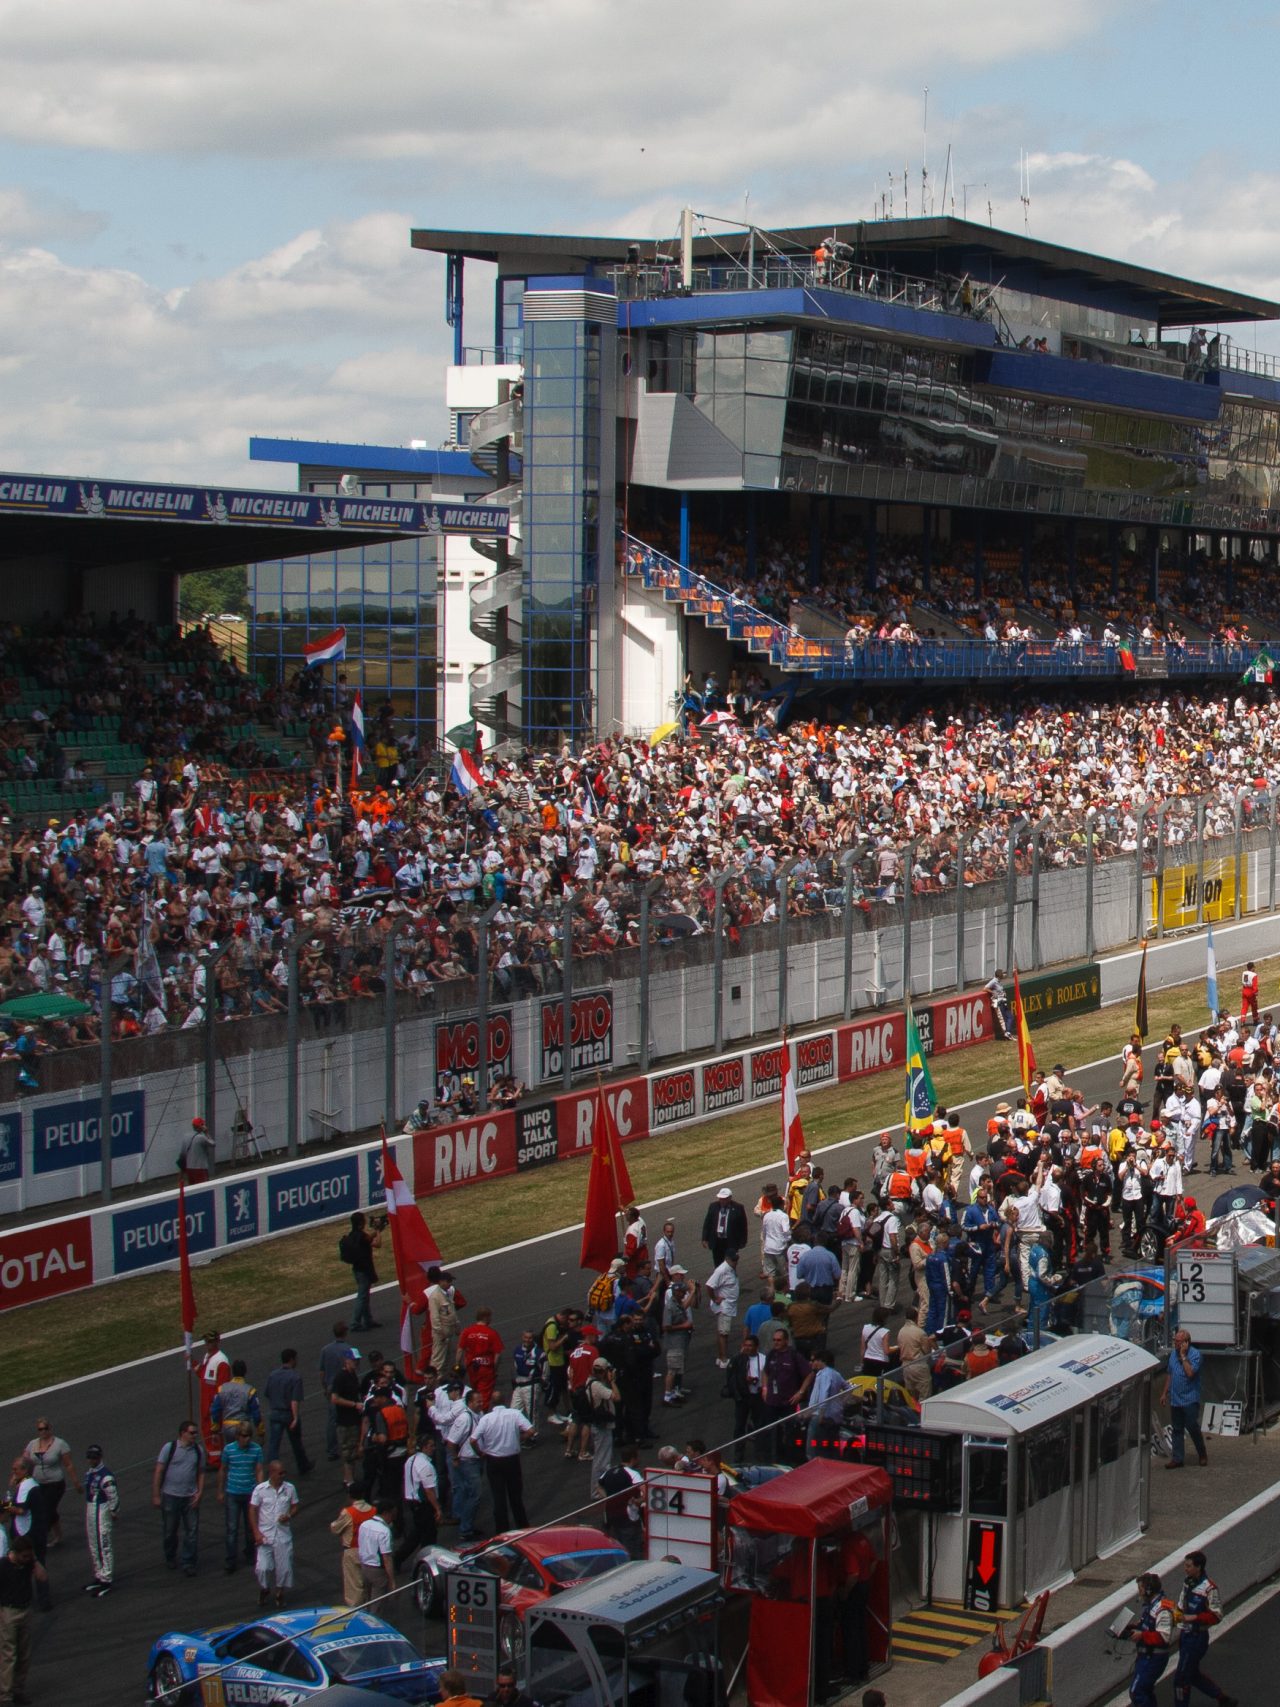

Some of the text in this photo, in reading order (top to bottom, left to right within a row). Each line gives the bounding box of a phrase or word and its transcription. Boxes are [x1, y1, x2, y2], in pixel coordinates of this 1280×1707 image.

[107, 489, 194, 511] MICHELIN
[231, 497, 310, 518] MICHELIN
[343, 504, 414, 523] MICHELIN
[444, 510, 508, 528] MICHELIN
[1010, 995, 1043, 1016] RLEX
[1057, 982, 1088, 1004] ROLEX
[945, 999, 984, 1048] RMC
[797, 1036, 833, 1069] MOTO
[850, 1022, 894, 1073] RMC
[702, 1060, 744, 1095] MOTO
[752, 1049, 783, 1082] MOT
[652, 1072, 695, 1108] MOTO
[524, 1108, 550, 1129] INFO
[522, 1125, 552, 1145] TALK
[434, 1122, 498, 1188] RMC
[518, 1140, 558, 1164] SPORT
[278, 1174, 350, 1212] PEUGEOT
[650, 1487, 686, 1515] 84
[456, 1580, 488, 1608] 85
